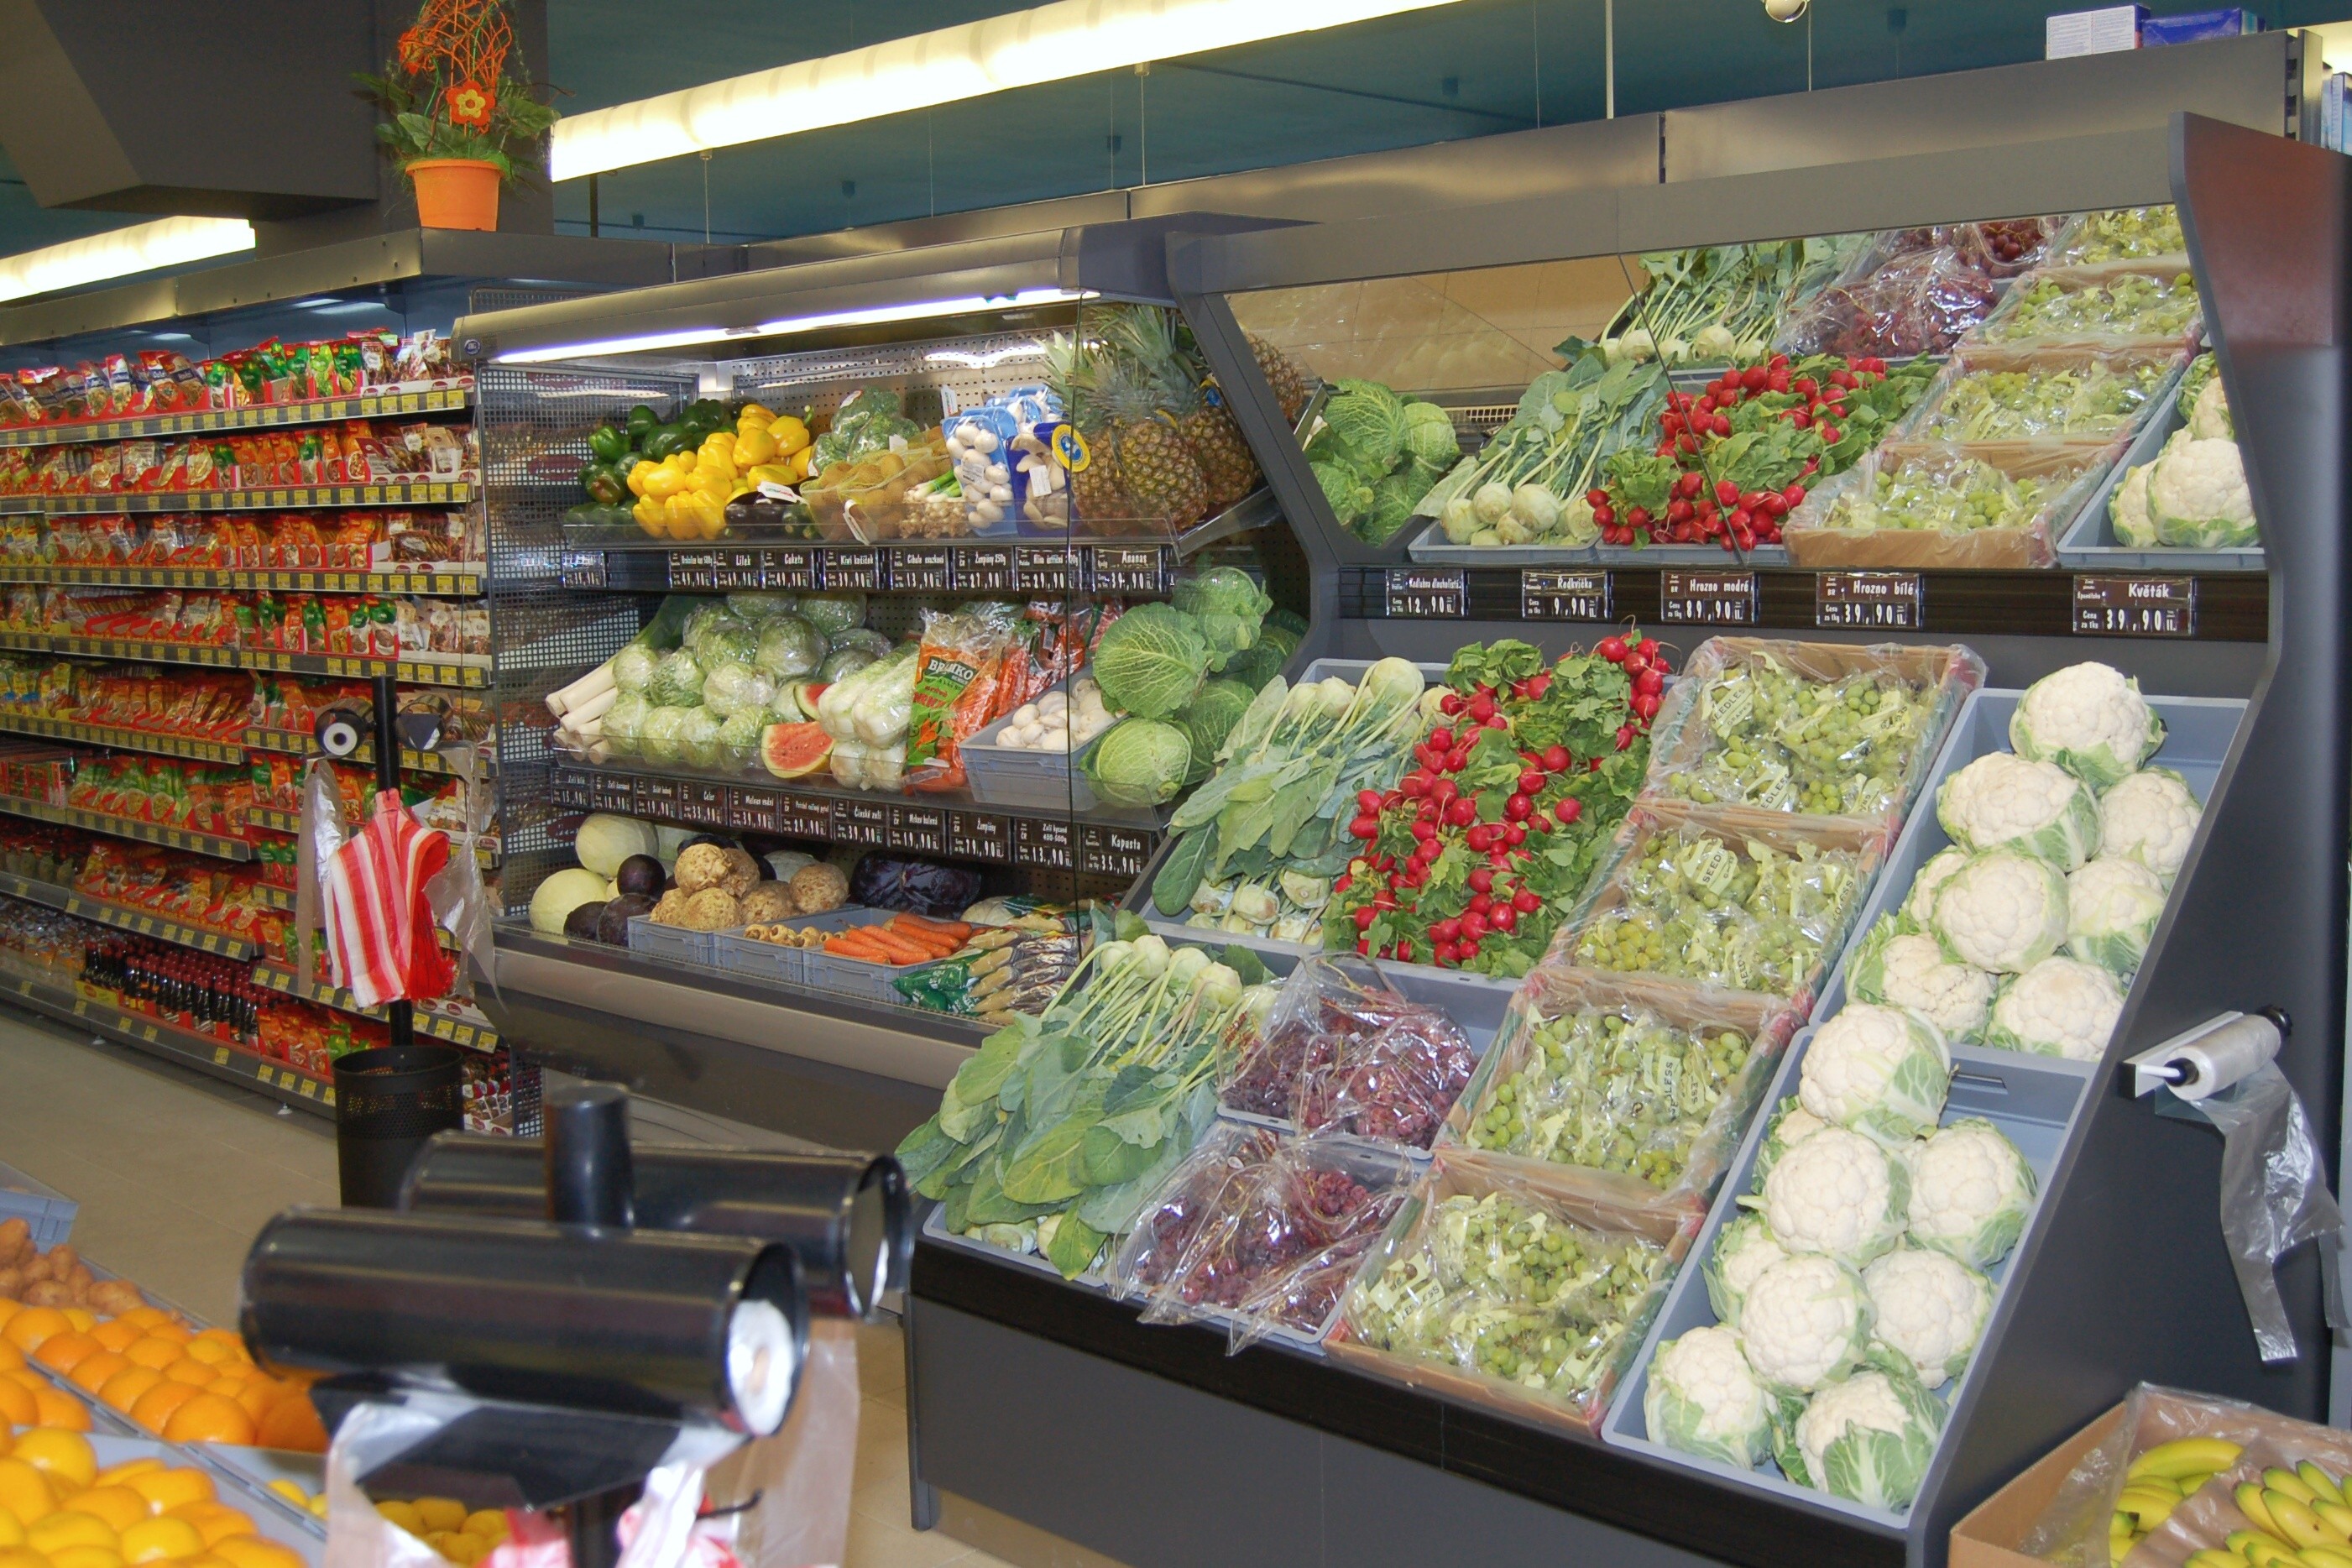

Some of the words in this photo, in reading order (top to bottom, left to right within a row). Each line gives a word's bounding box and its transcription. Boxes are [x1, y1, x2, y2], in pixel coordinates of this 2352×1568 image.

[735, 554, 751, 566] Lilek
[1121, 551, 1147, 564] Ananas
[1558, 575, 1592, 589] Ředkvička
[1690, 578, 1718, 593] Hrozno
[1723, 579, 1749, 593] modré
[1853, 580, 1887, 594] Hrozno
[1894, 581, 1914, 596] bílé
[2128, 583, 2170, 598] Květák
[1409, 596, 1445, 615] 12,90
[1554, 597, 1586, 616] 9,90
[1669, 601, 1680, 609] Cena
[1686, 600, 1731, 621] 89,90
[1825, 604, 1837, 613] Cena
[1845, 604, 1893, 625] 39,90
[2083, 610, 2097, 619] Cena
[2107, 609, 2162, 631] 39,90
[1043, 823, 1053, 832] Zelí
[1111, 834, 1141, 851] Kapusta
